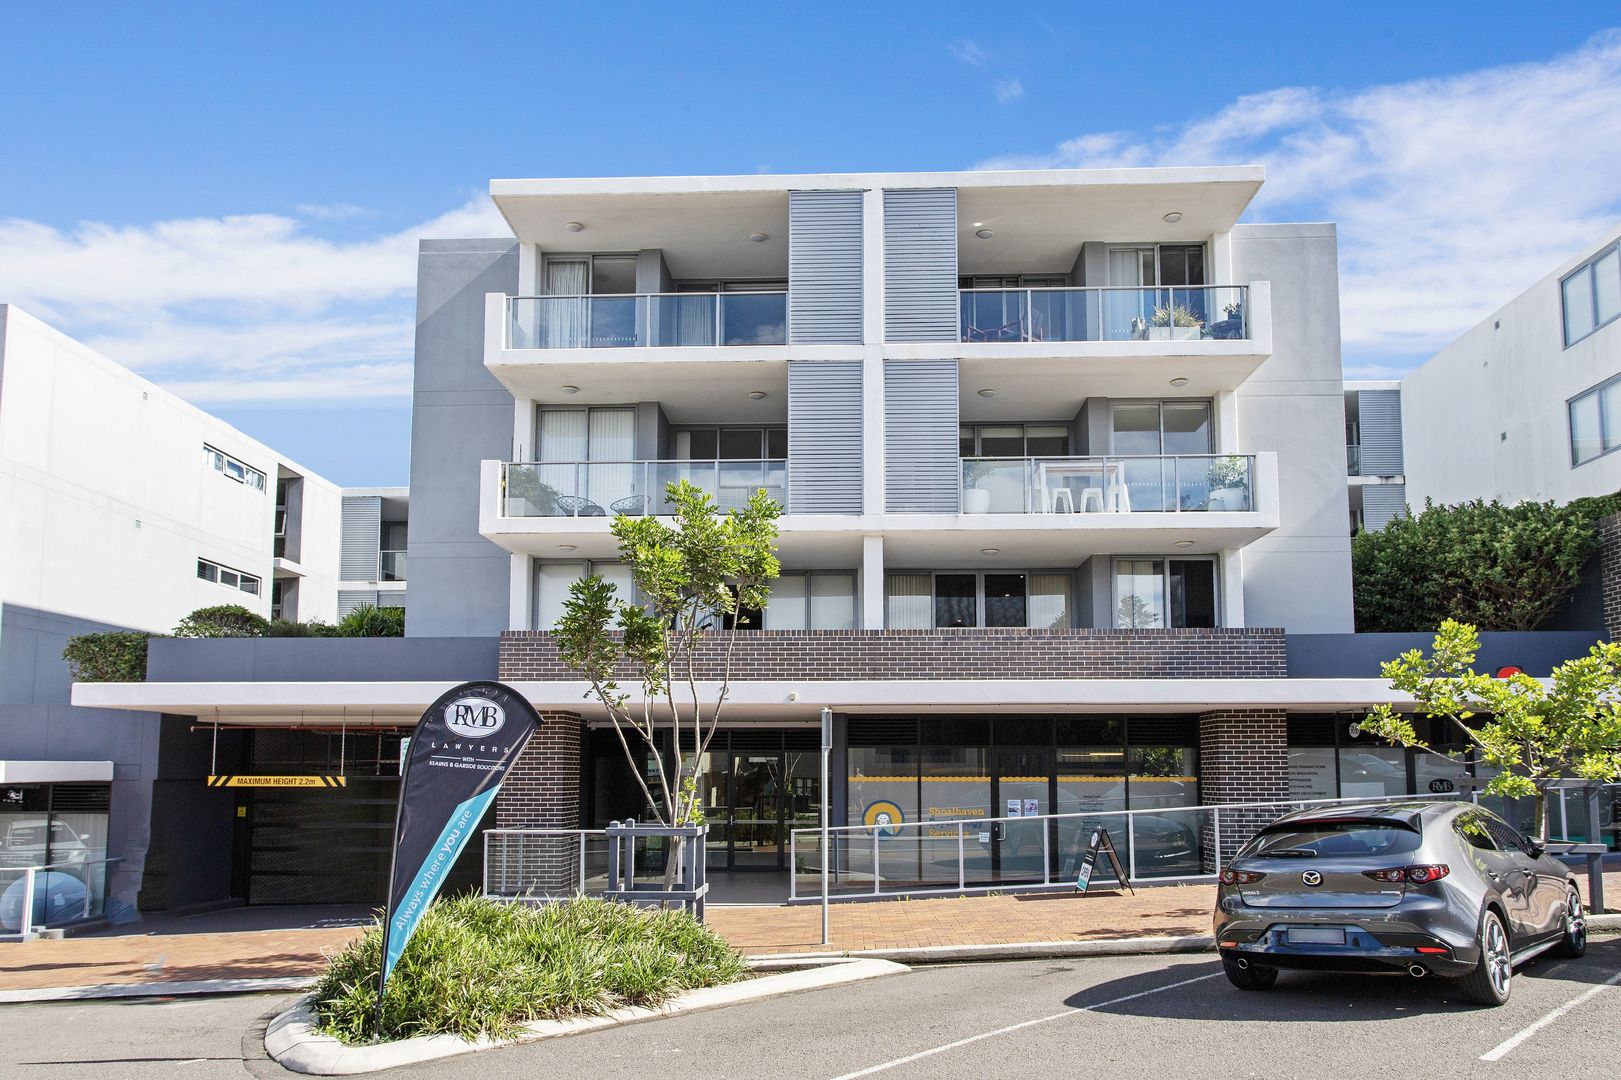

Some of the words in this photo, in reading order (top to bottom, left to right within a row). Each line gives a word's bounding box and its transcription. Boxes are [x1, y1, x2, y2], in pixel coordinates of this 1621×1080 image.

[452, 704, 497, 729] RMB
[431, 741, 509, 754] LAWYERS
[429, 760, 449, 768] KEARNS
[454, 762, 476, 770] GARSIDE
[477, 764, 506, 772] SOLICITORS
[237, 777, 271, 785] MAXIMUM
[273, 777, 298, 785] HEIGHT
[298, 777, 316, 785] 2.2m
[1432, 781, 1452, 791] RMB
[928, 806, 985, 816] Shoalhaven
[928, 829, 970, 838] Servics
[395, 891, 424, 931] Always
[420, 853, 446, 889] where
[441, 830, 459, 853] you
[457, 810, 473, 829] are
